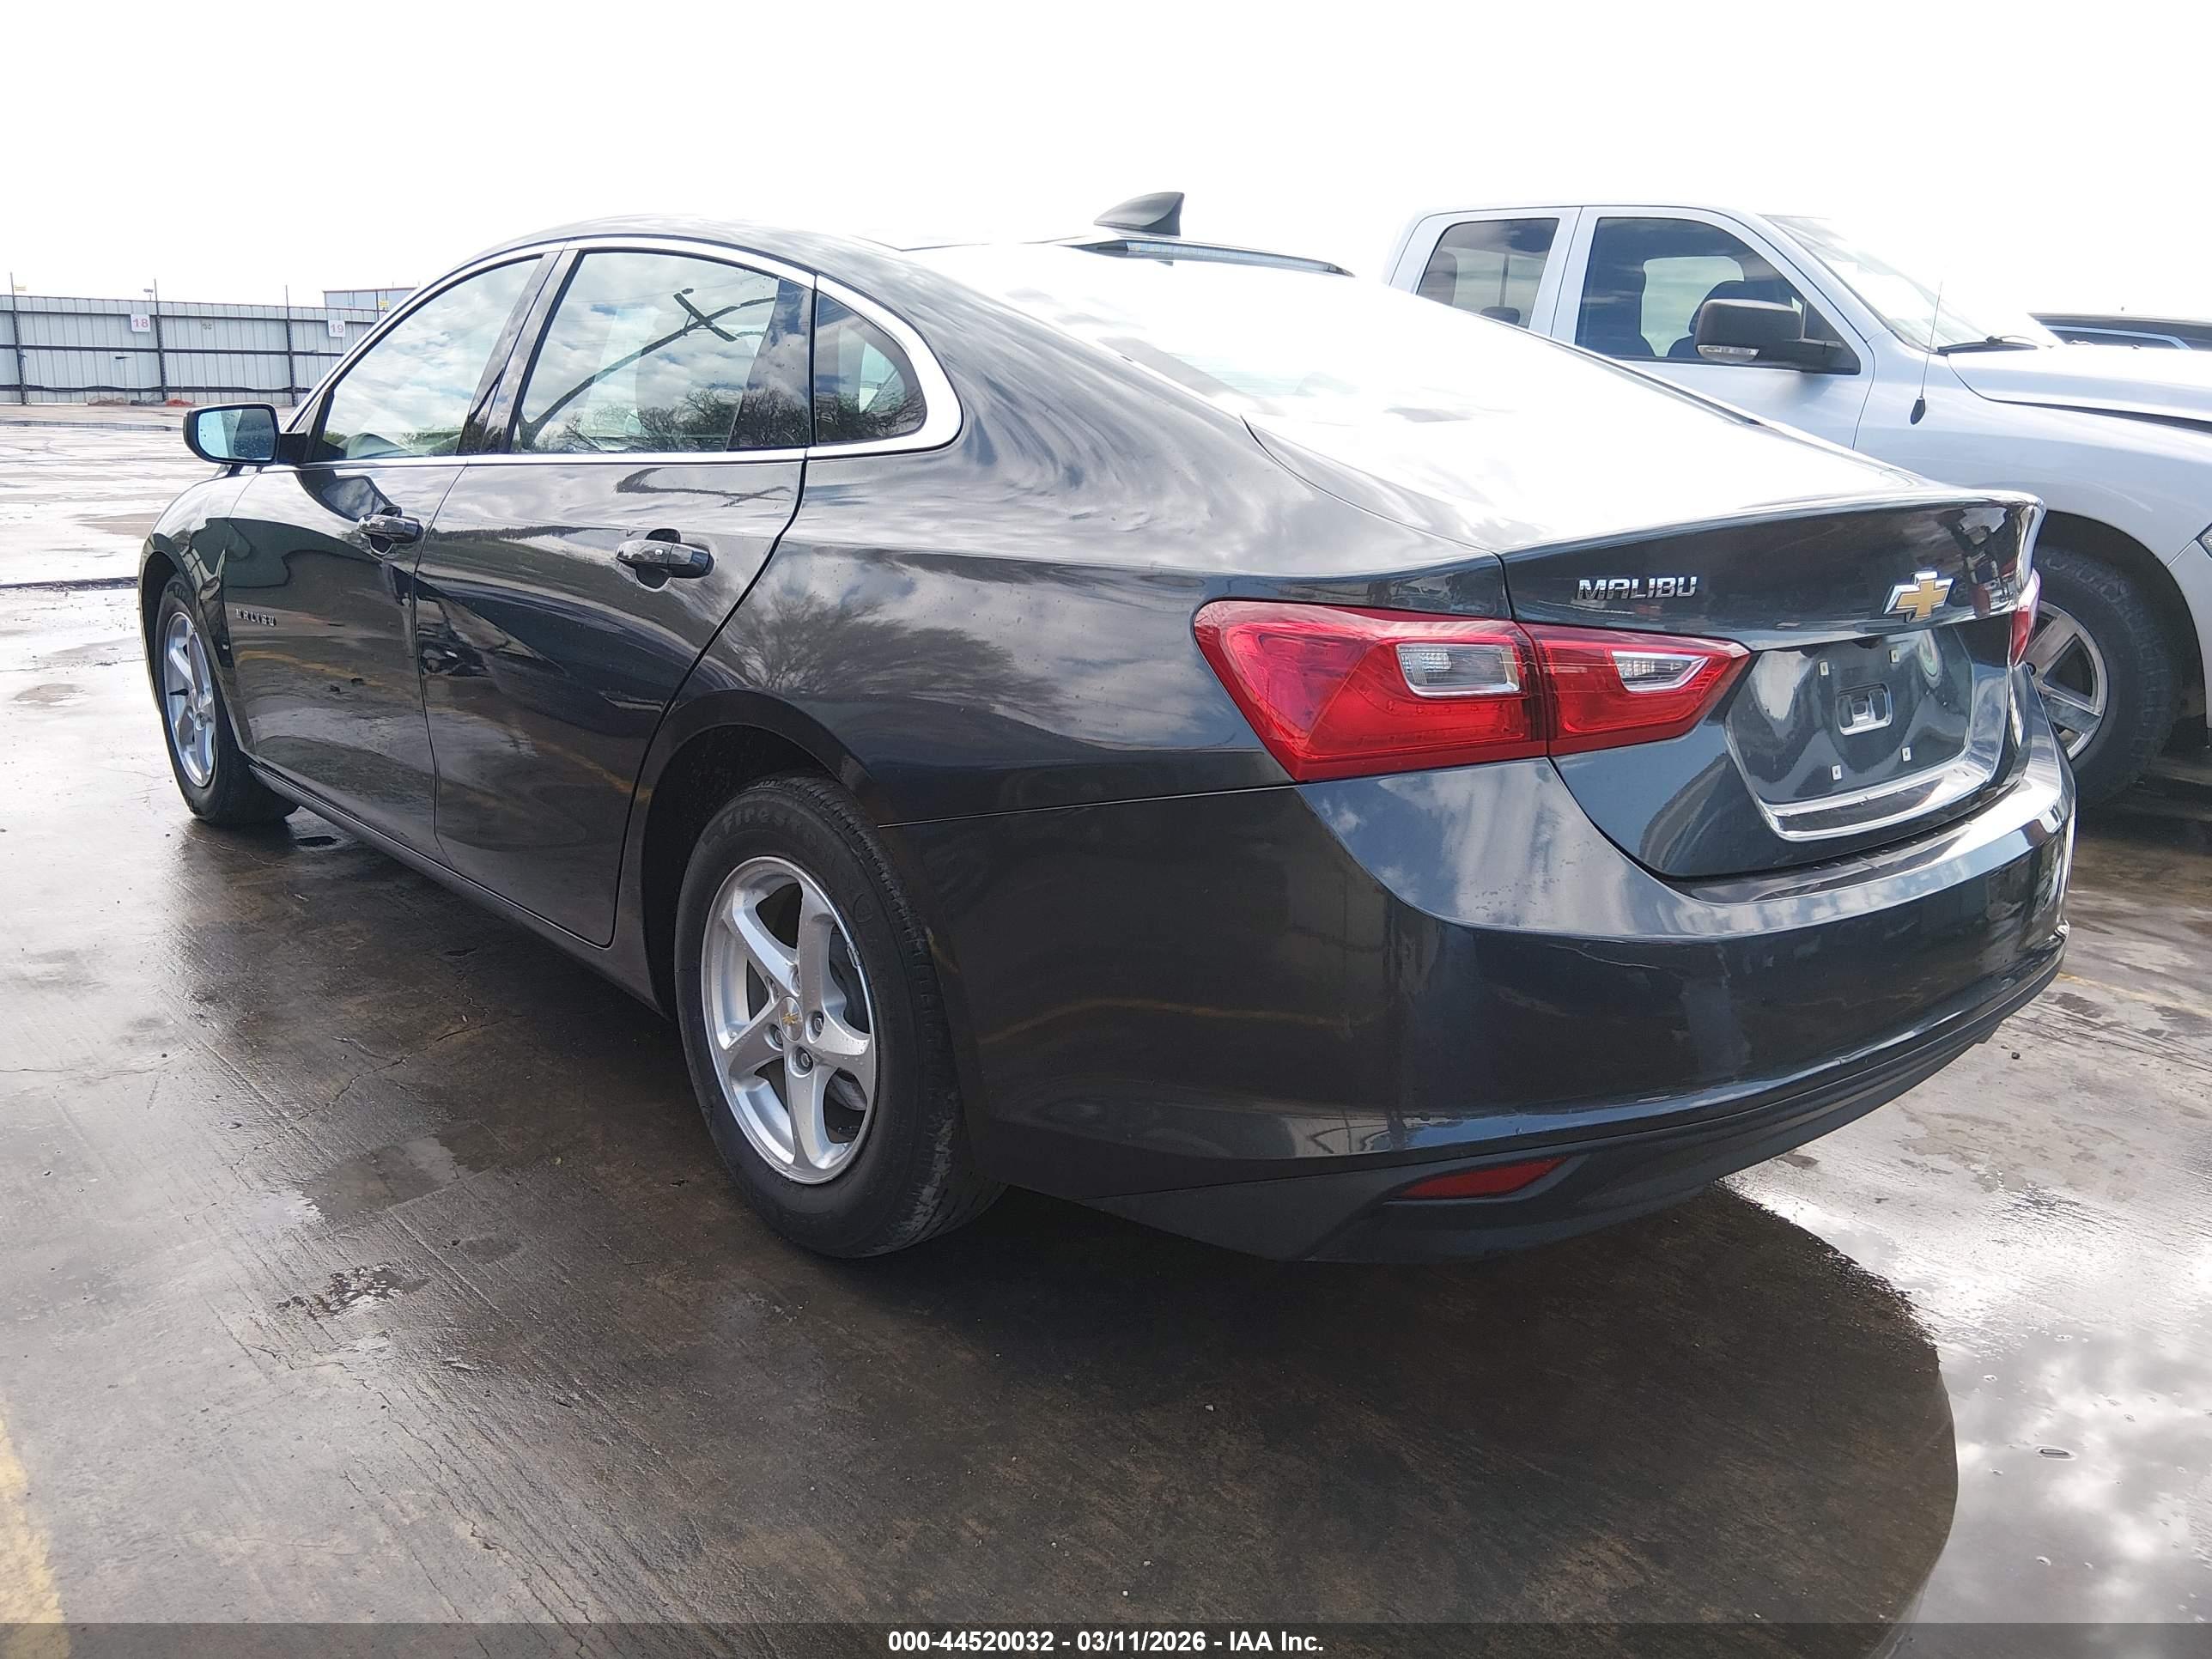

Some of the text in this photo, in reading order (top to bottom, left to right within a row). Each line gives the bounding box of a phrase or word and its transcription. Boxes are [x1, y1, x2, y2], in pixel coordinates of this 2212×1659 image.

[132, 318, 149, 328] 18
[330, 323, 344, 333] 19
[1577, 576, 1698, 599] MALIBU
